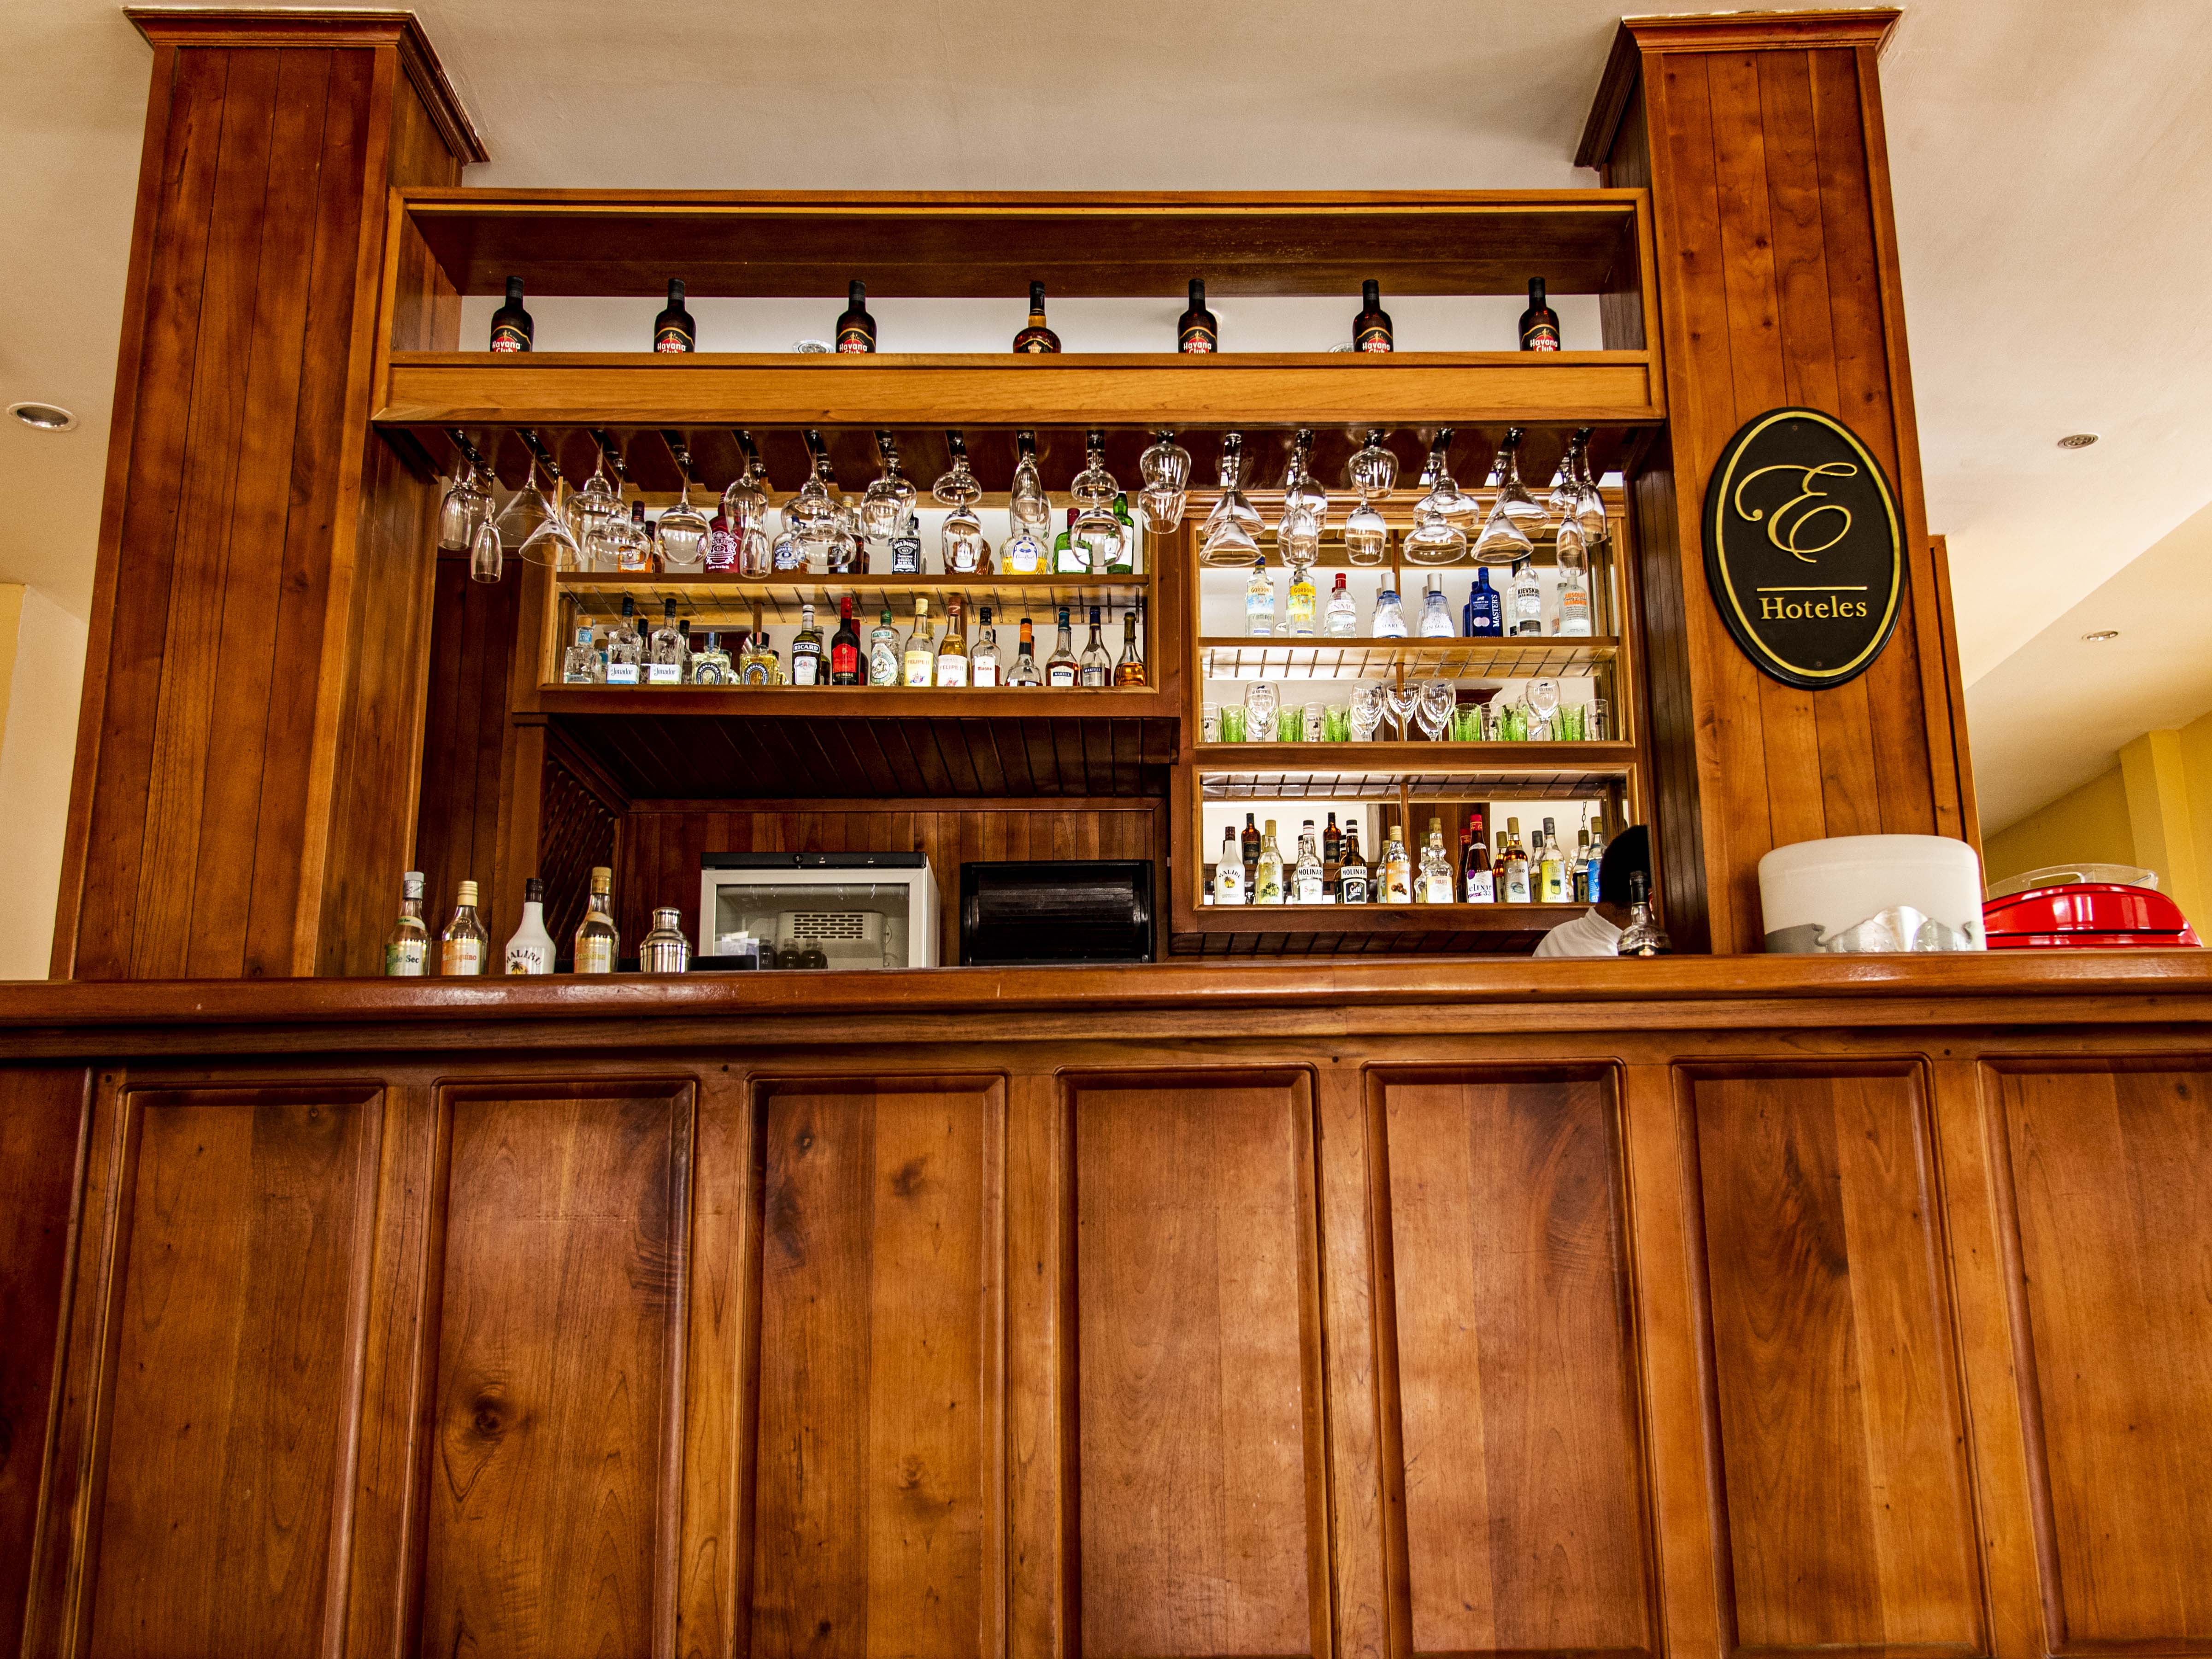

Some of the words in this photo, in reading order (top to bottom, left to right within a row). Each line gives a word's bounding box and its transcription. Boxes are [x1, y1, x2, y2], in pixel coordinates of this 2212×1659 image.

[492, 341, 520, 349] Havana
[657, 342, 686, 351] Havana
[839, 343, 867, 352] Havana
[1183, 341, 1212, 350] Havana
[1363, 342, 1390, 350] Havana
[1530, 339, 1557, 347] Havana
[1491, 594, 1500, 627] MASTER'S
[1758, 595, 1868, 620] Hoteles
[406, 954, 419, 963] Sec
[506, 949, 542, 965] MALIBU
